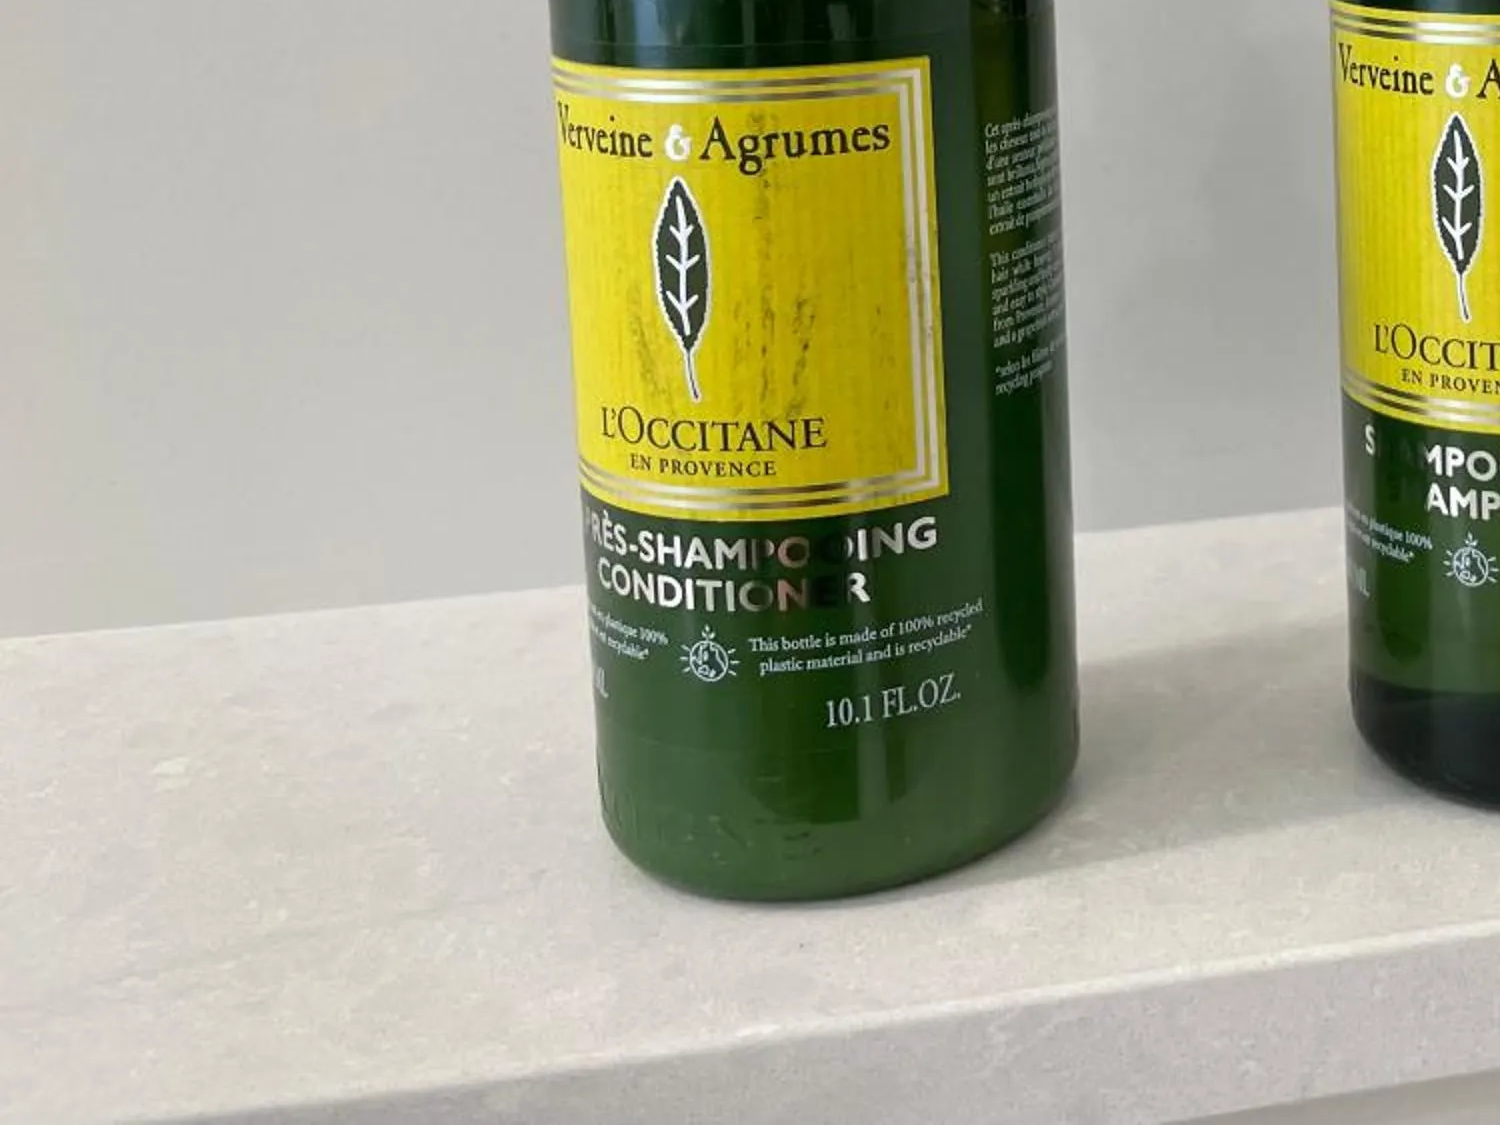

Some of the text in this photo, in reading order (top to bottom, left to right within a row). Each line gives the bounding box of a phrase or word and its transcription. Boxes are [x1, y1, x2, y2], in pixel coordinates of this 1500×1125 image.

[1338, 42, 1434, 95] Verveine
[1445, 63, 1471, 99] &
[557, 100, 890, 175] Verveine & Agrumes
[1402, 368, 1422, 384] EN
[631, 453, 776, 476] EN PROVENCE
[748, 597, 983, 652] This bottle is made of 100% recycled
[759, 656, 803, 676] plastic
[807, 650, 863, 670] material
[866, 647, 891, 662] and
[895, 640, 905, 656] is
[826, 695, 874, 728] 10.1
